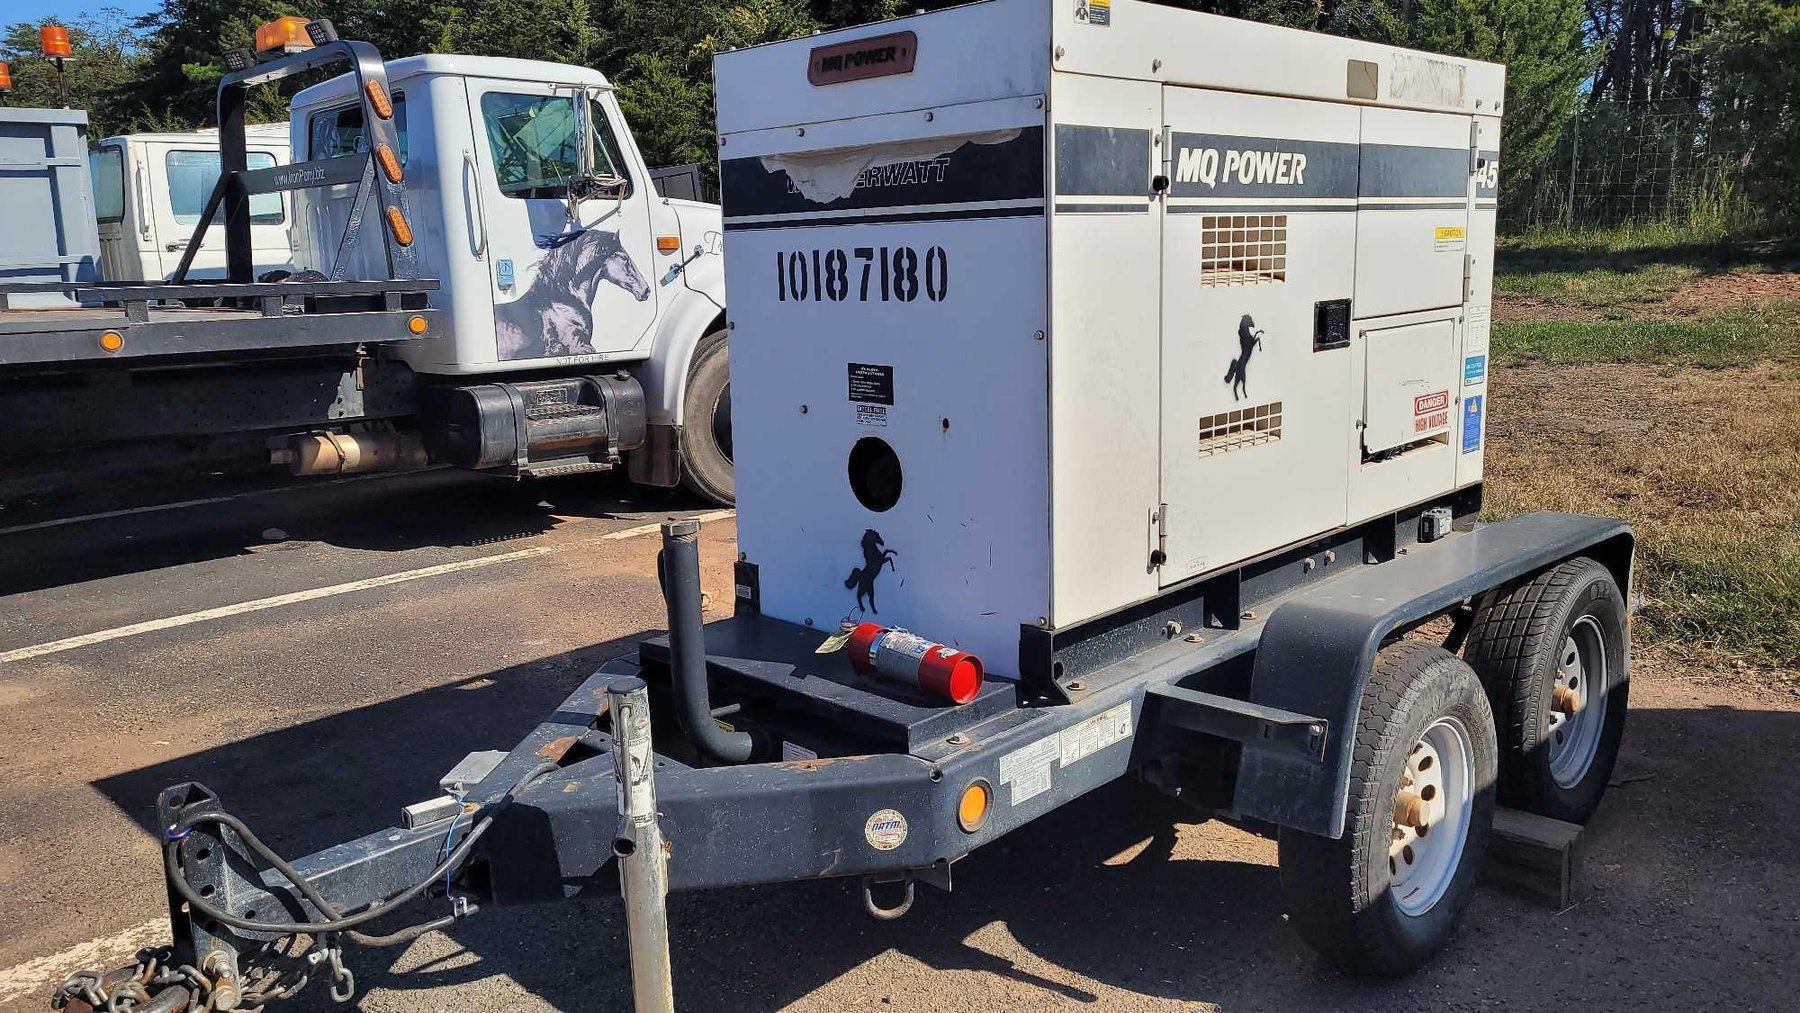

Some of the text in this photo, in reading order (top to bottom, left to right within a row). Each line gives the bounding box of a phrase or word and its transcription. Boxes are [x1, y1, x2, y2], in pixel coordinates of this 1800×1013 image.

[821, 46, 897, 72] MQ POWER
[1175, 147, 1307, 190] MQ POWER
[777, 245, 948, 302] 10187180
[1418, 395, 1445, 411] DANGER
[1415, 411, 1448, 432] HIGH VOLTAGE
